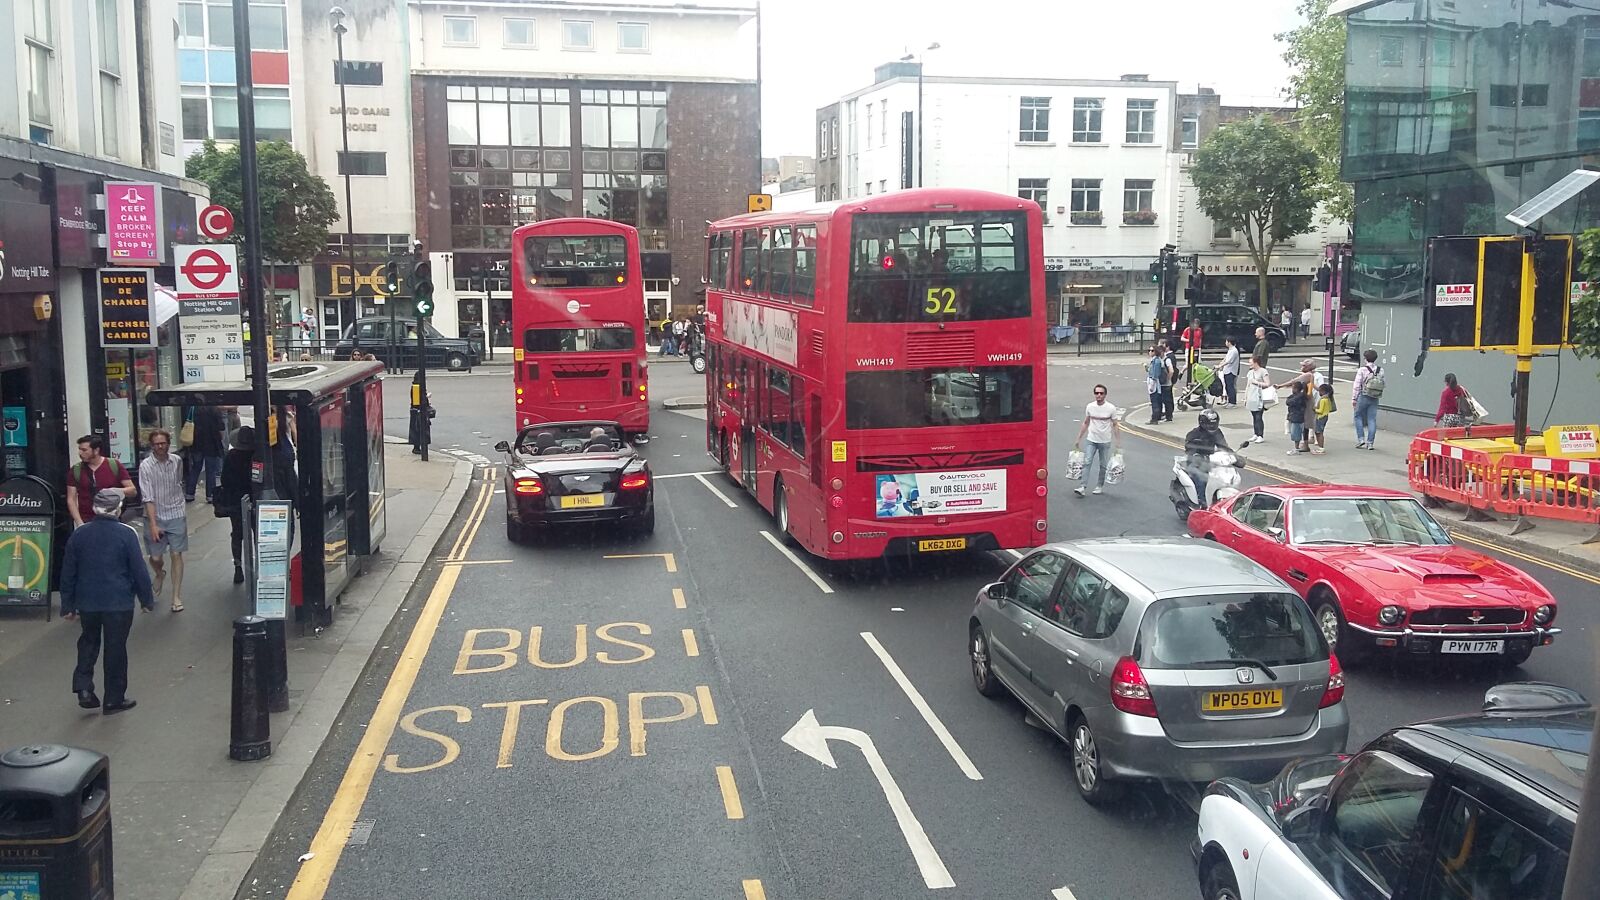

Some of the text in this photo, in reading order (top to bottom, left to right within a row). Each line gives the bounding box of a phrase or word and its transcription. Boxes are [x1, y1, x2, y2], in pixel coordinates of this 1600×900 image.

[329, 107, 390, 116] DAVID GAME
[345, 123, 377, 132] HOUSE
[74, 206, 82, 216] 24
[120, 214, 147, 222] CALM
[205, 210, 228, 235] C
[60, 217, 98, 231] PEMBRIDGE ROAD
[116, 223, 151, 231] BROKEN
[11, 265, 50, 281] Notting Hill Tube
[1446, 285, 1473, 294] LUX
[925, 287, 957, 314] 52
[856, 358, 894, 366] VWH1419
[987, 353, 1023, 362] VWH1419
[1568, 432, 1593, 441] LUX
[930, 482, 998, 494] BUY OR SELL AND SAVE
[577, 496, 593, 505] HNL
[922, 540, 962, 550] LK62 DXG
[452, 622, 656, 675] BUS
[1449, 641, 1498, 652] PYN 177R
[1212, 691, 1279, 707] WP05 OYL
[383, 691, 698, 773] STOP
